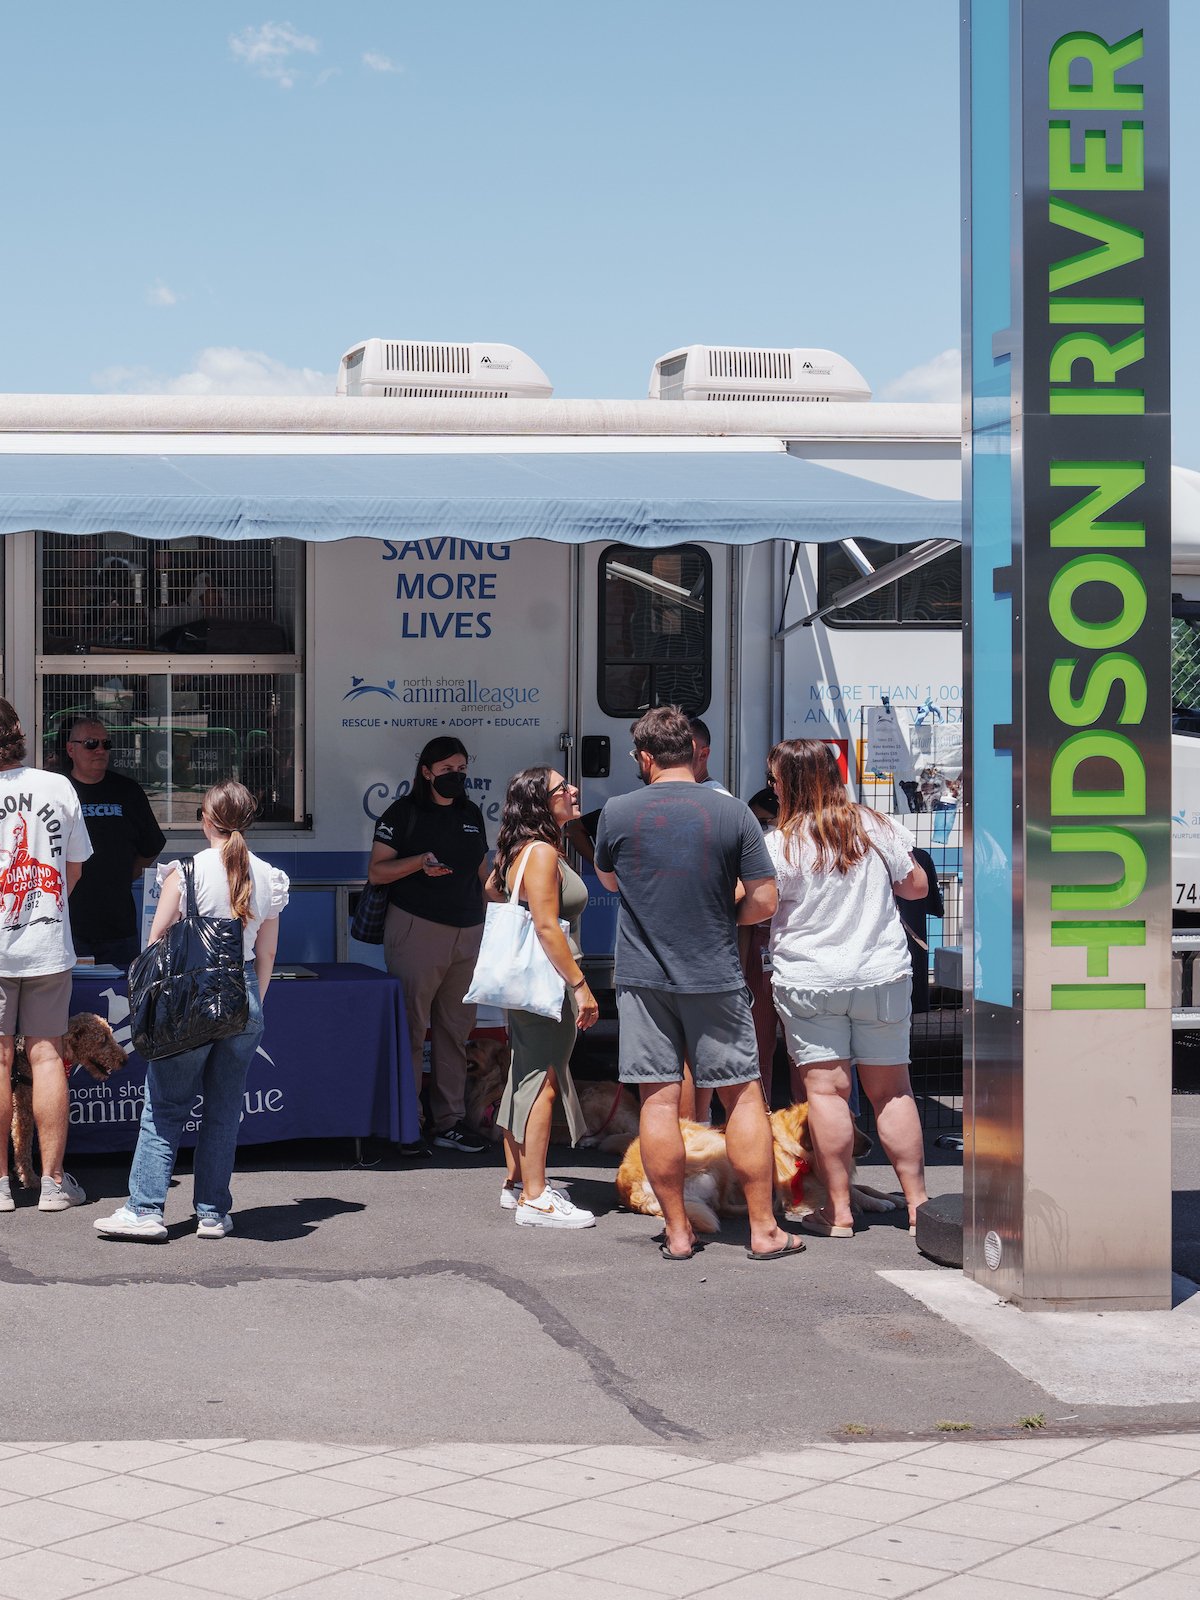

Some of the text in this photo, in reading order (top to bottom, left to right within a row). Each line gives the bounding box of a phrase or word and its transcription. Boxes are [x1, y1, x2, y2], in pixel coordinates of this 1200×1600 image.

[1049, 28, 1146, 1010] HUDSON RIVER
[382, 537, 511, 561] SAVING
[396, 573, 497, 600] MORE
[401, 612, 492, 638] LIVES
[403, 676, 465, 687] north shore
[402, 680, 540, 709] animalleague
[809, 685, 862, 700] MORE
[868, 685, 918, 701] THAN
[341, 717, 540, 727] RESCUE NURTURE ADOPT EDUCATE
[81, 803, 123, 816] ESCUE
[37, 803, 62, 858] HOLE
[6, 864, 51, 885] DIAMOND
[13, 877, 43, 893] CROSS
[1175, 883, 1200, 904] 74
[24, 900, 40, 912] 1912
[68, 1081, 145, 1100] north sho
